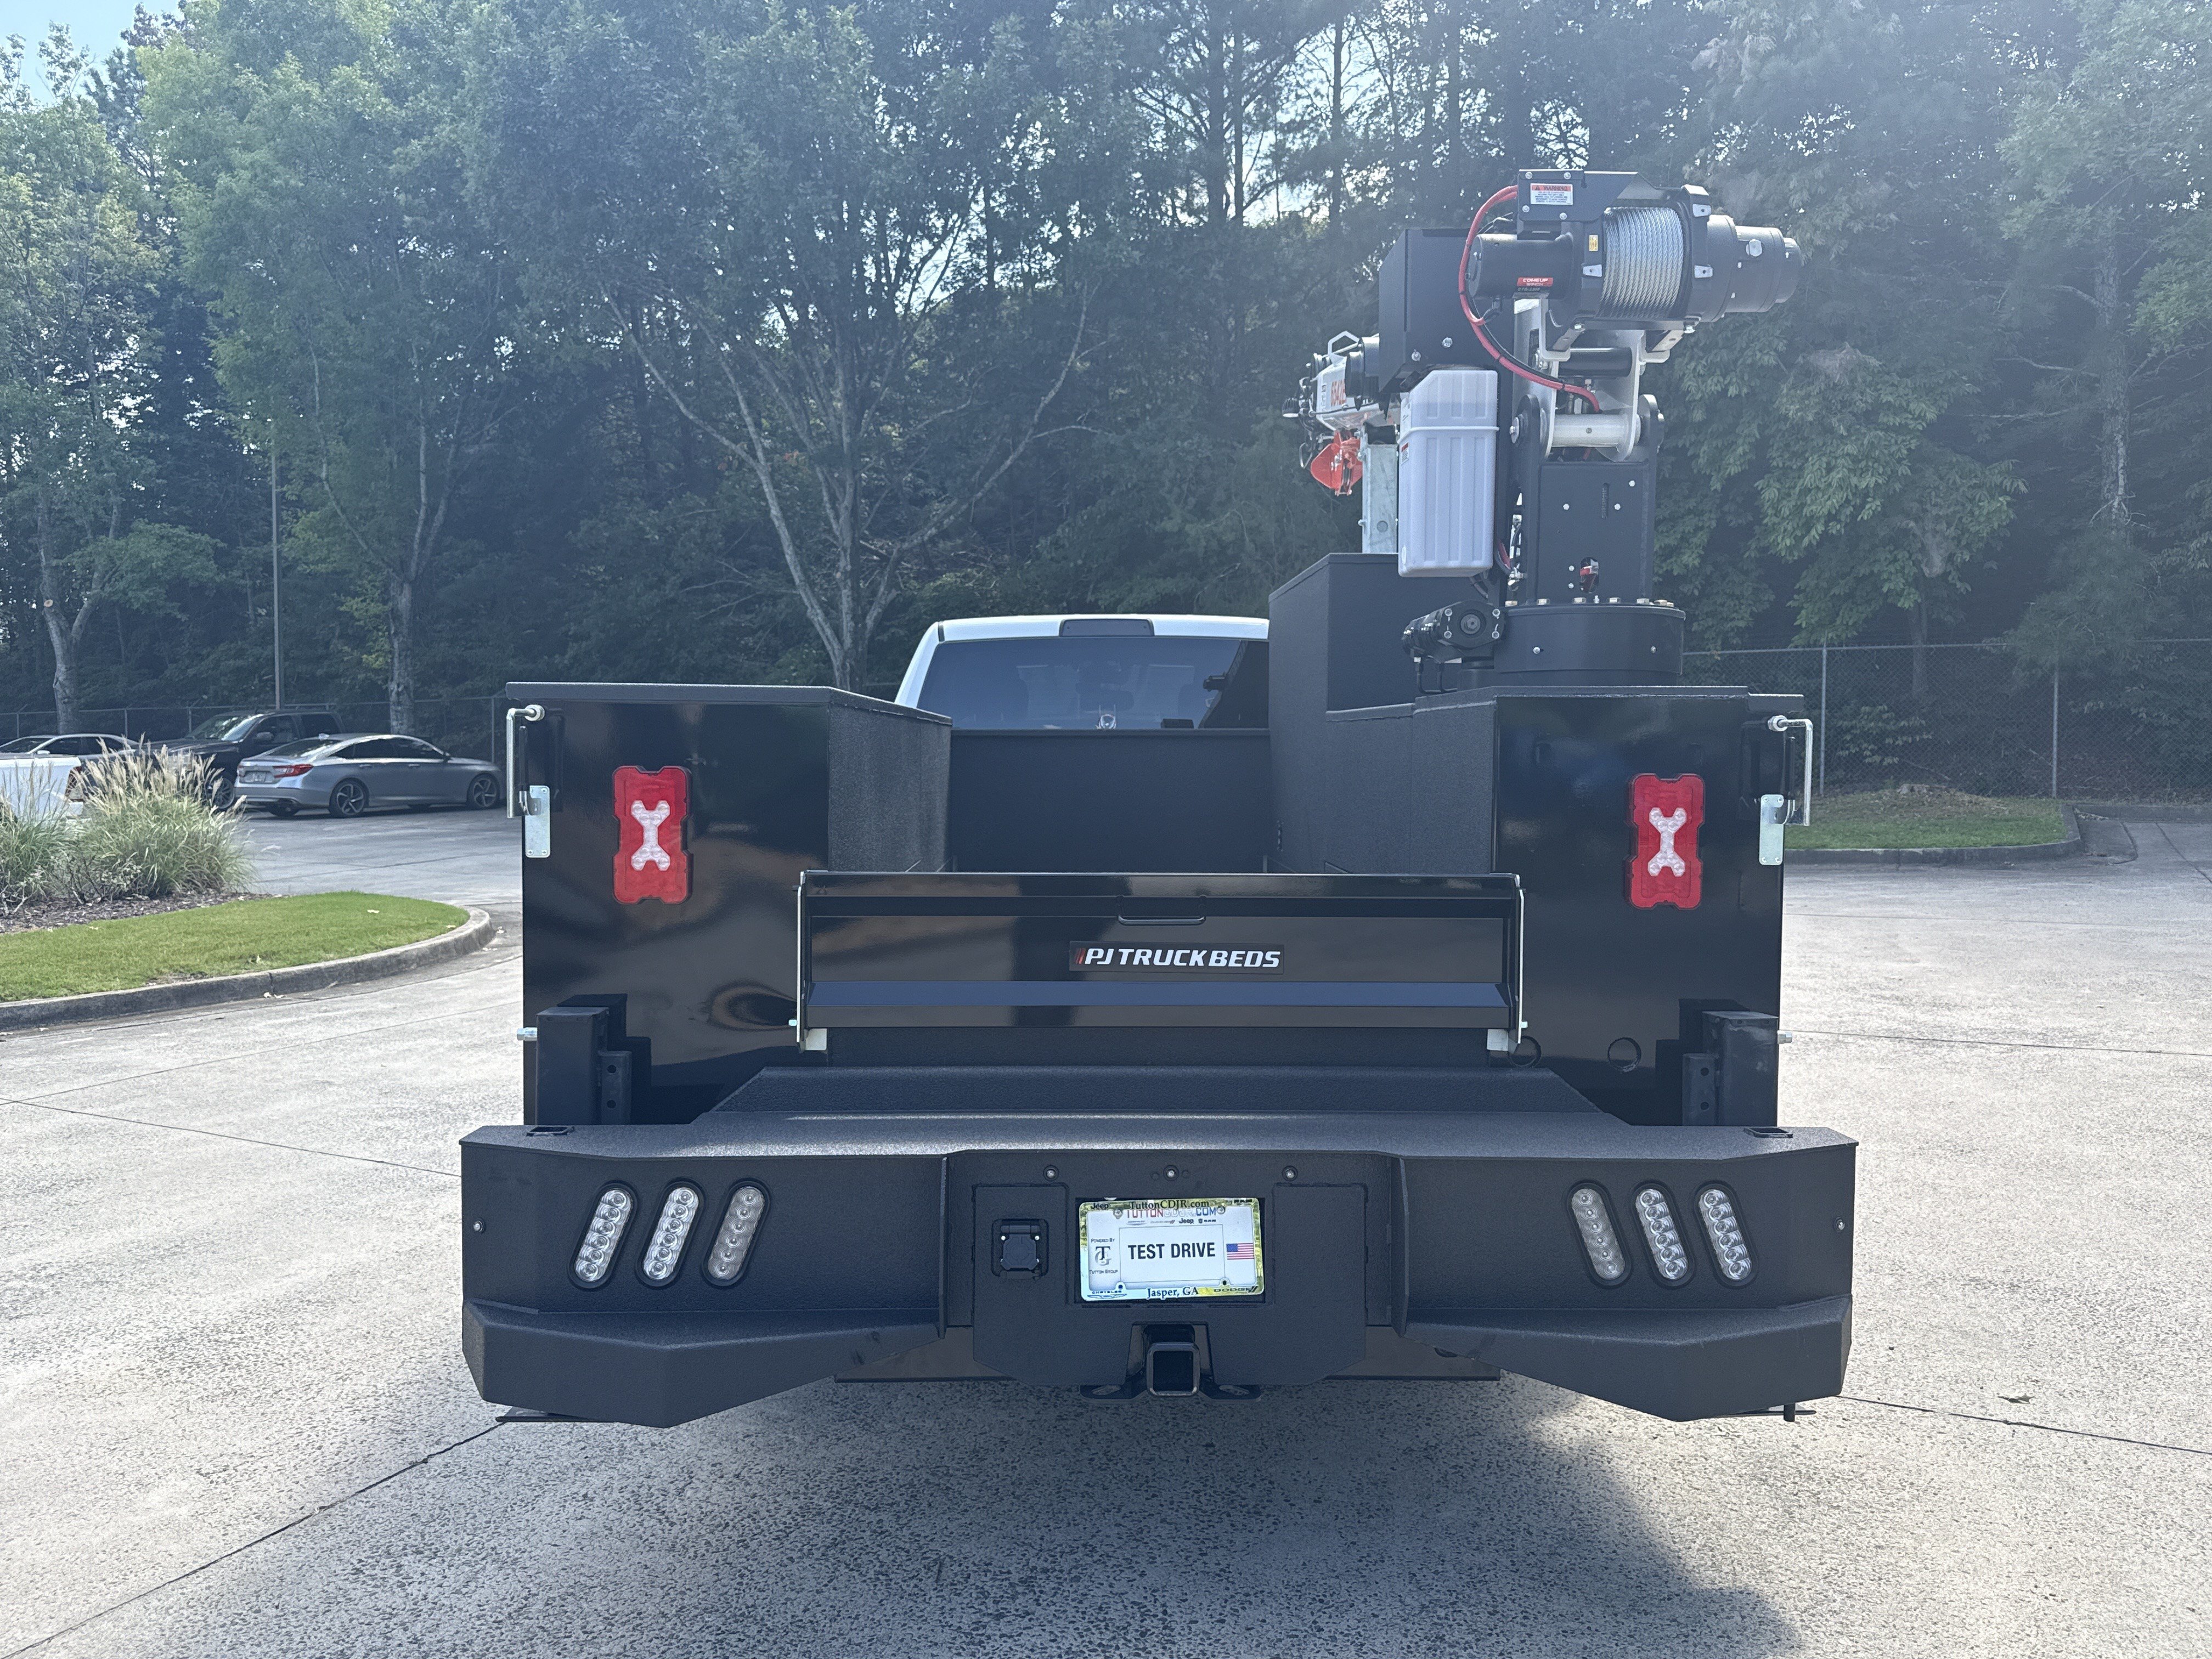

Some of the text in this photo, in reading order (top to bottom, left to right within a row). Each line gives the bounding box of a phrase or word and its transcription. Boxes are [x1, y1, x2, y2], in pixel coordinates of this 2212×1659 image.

[1085, 948, 1281, 968] PJ TRUCK BEDS
[1130, 1200, 1210, 1210] TuttonCDJR.com
[1127, 1242, 1216, 1260] TEST DRIVE
[1147, 1286, 1199, 1299] Jasper, GA
